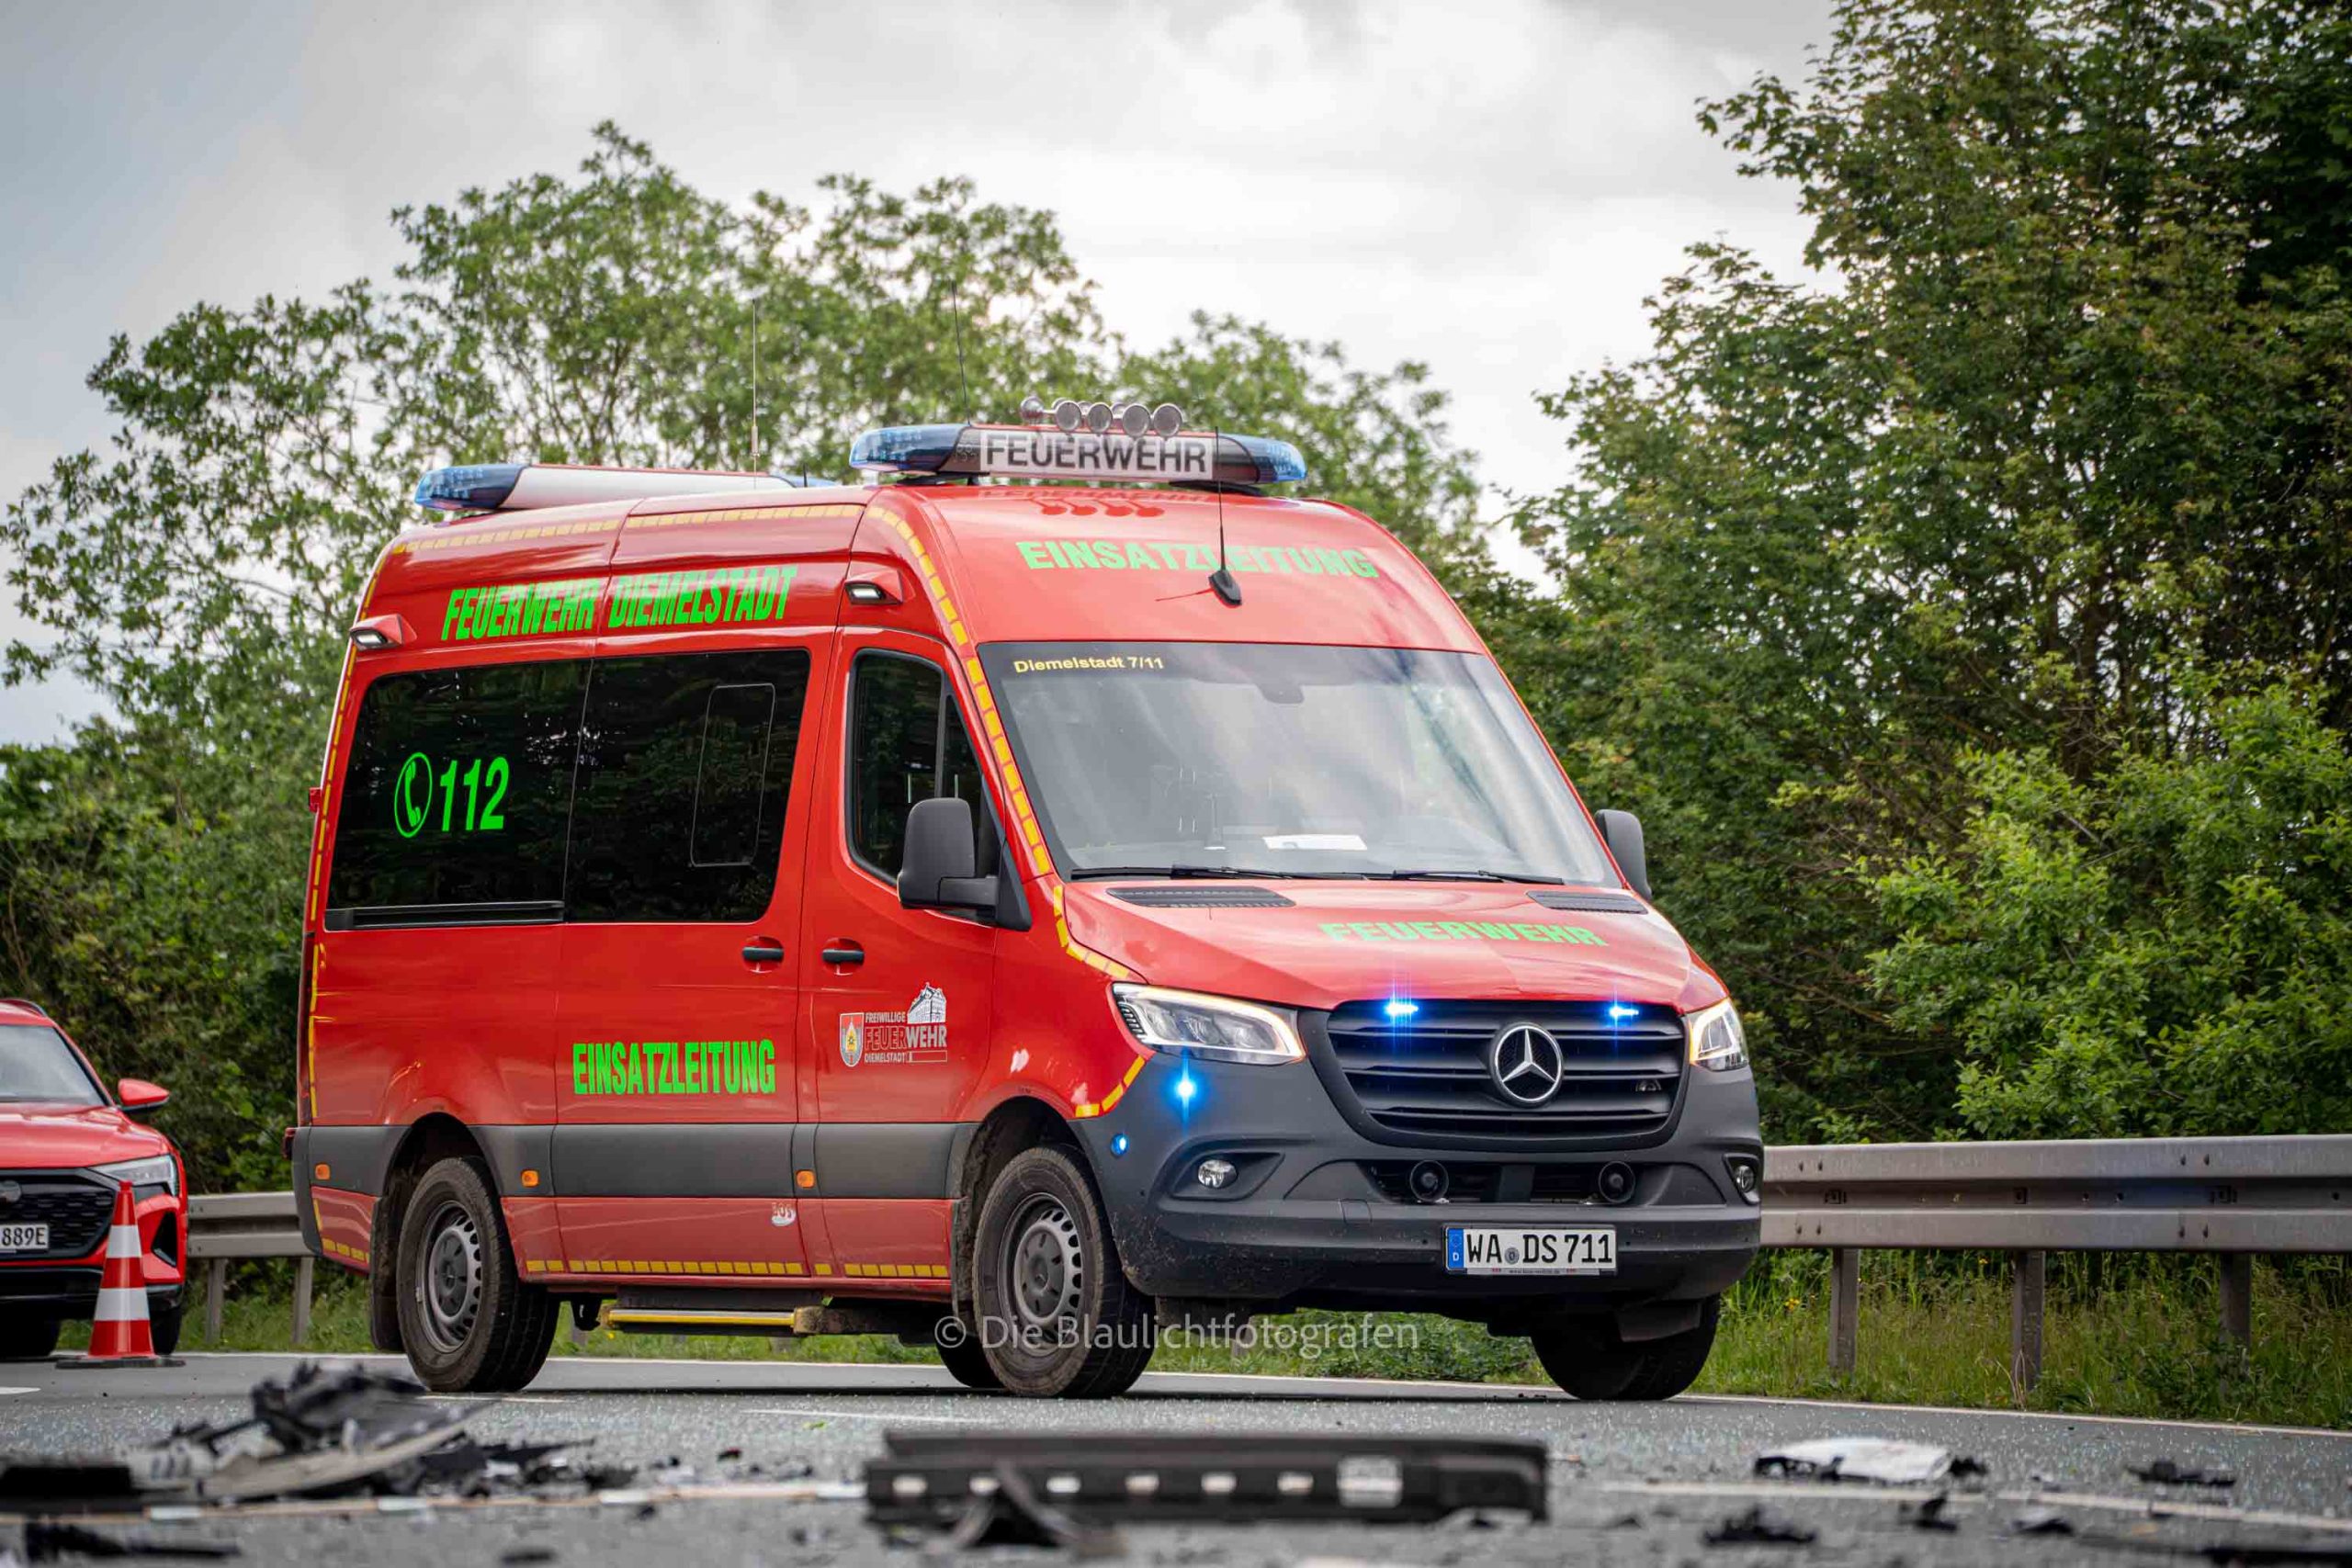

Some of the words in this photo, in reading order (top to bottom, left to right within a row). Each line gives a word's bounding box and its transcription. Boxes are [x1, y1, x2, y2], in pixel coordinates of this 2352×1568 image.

[986, 433, 1206, 473] FEUERWEHR
[1016, 540, 1379, 579] EINSATZLEITUNG
[441, 578, 601, 641] FEUERWEHR
[607, 565, 797, 629] DIEMELSTADT
[1013, 656, 1125, 673] Diemelstadt
[1127, 656, 1165, 670] 7/11
[438, 755, 511, 834] 112
[1319, 920, 1608, 946] FEUERWEHR
[865, 1011, 907, 1023] FREIWILLIGE
[864, 1024, 947, 1051] FEUERWEHR
[572, 1039, 776, 1095] EINSATZLEITUNG
[865, 1051, 906, 1063] DIEMELSTADT
[1453, 1252, 1460, 1261] D
[1466, 1234, 1502, 1263] WA
[1522, 1234, 1557, 1263] DS
[1564, 1234, 1612, 1263] 711
